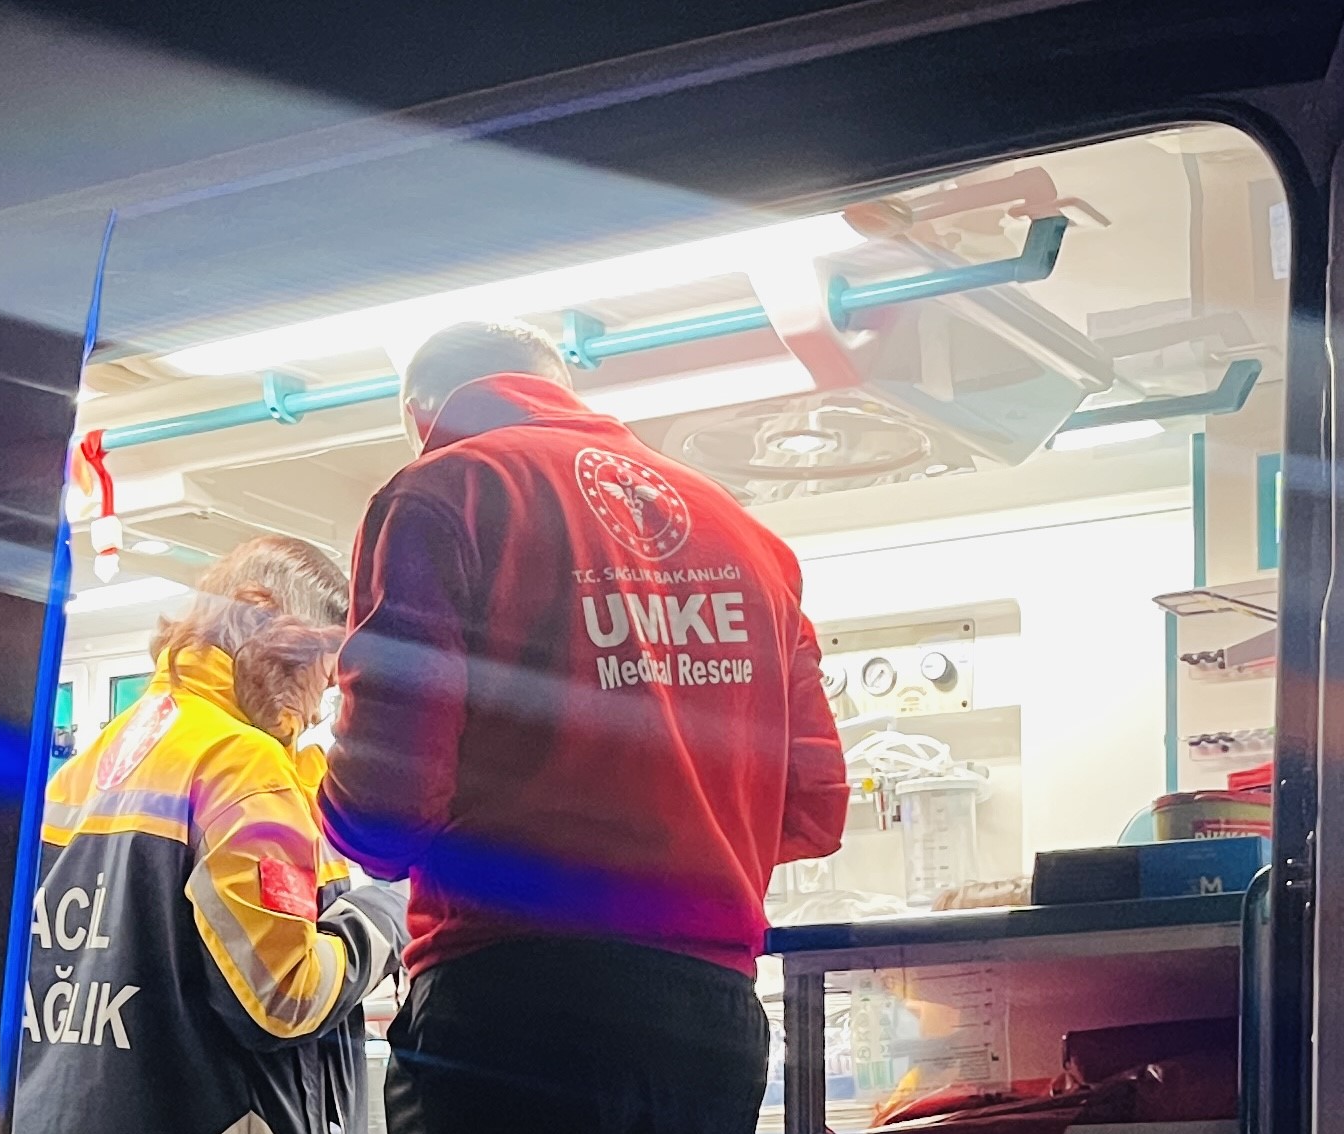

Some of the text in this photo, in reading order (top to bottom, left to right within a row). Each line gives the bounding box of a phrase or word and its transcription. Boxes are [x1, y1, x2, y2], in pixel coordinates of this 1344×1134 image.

[581, 591, 749, 648] UMKE
[596, 650, 753, 690] Medical Rescue
[22, 964, 141, 1050] AĞLIK
